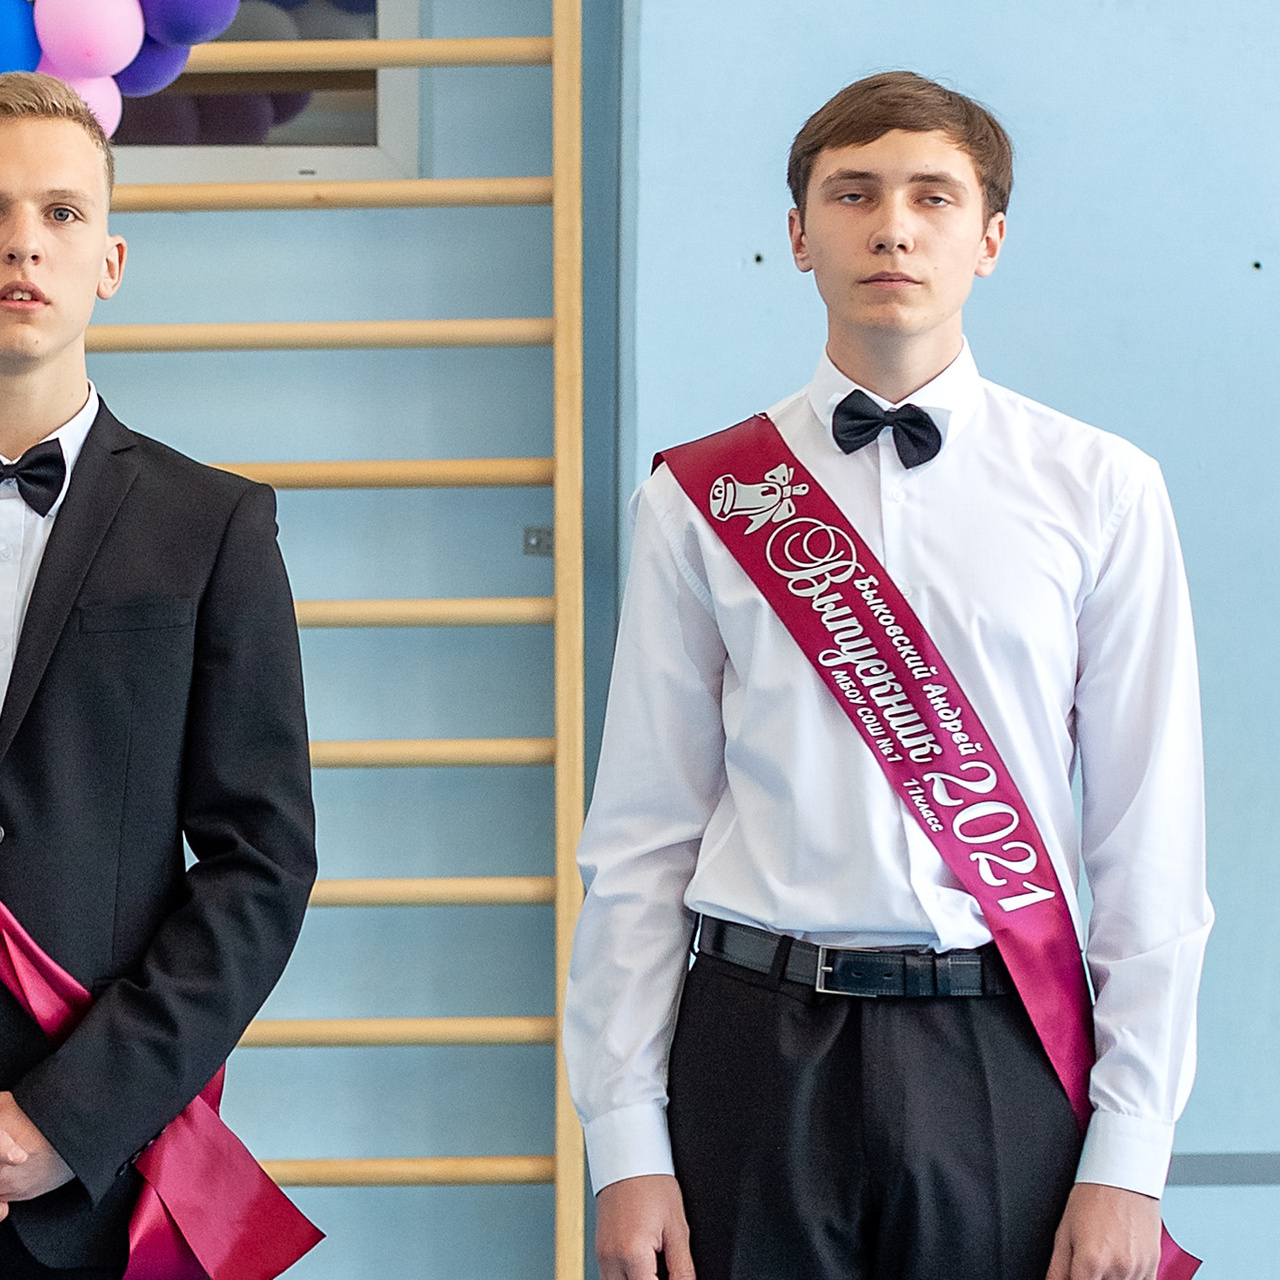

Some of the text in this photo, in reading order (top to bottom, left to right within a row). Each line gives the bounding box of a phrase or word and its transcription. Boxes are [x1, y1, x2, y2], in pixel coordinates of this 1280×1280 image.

[765, 517, 1055, 912] Выпускник 2021
[831, 670, 867, 705] МБОУ
[857, 707, 886, 736] СОШ
[854, 575, 983, 756] Быковский Андрей
